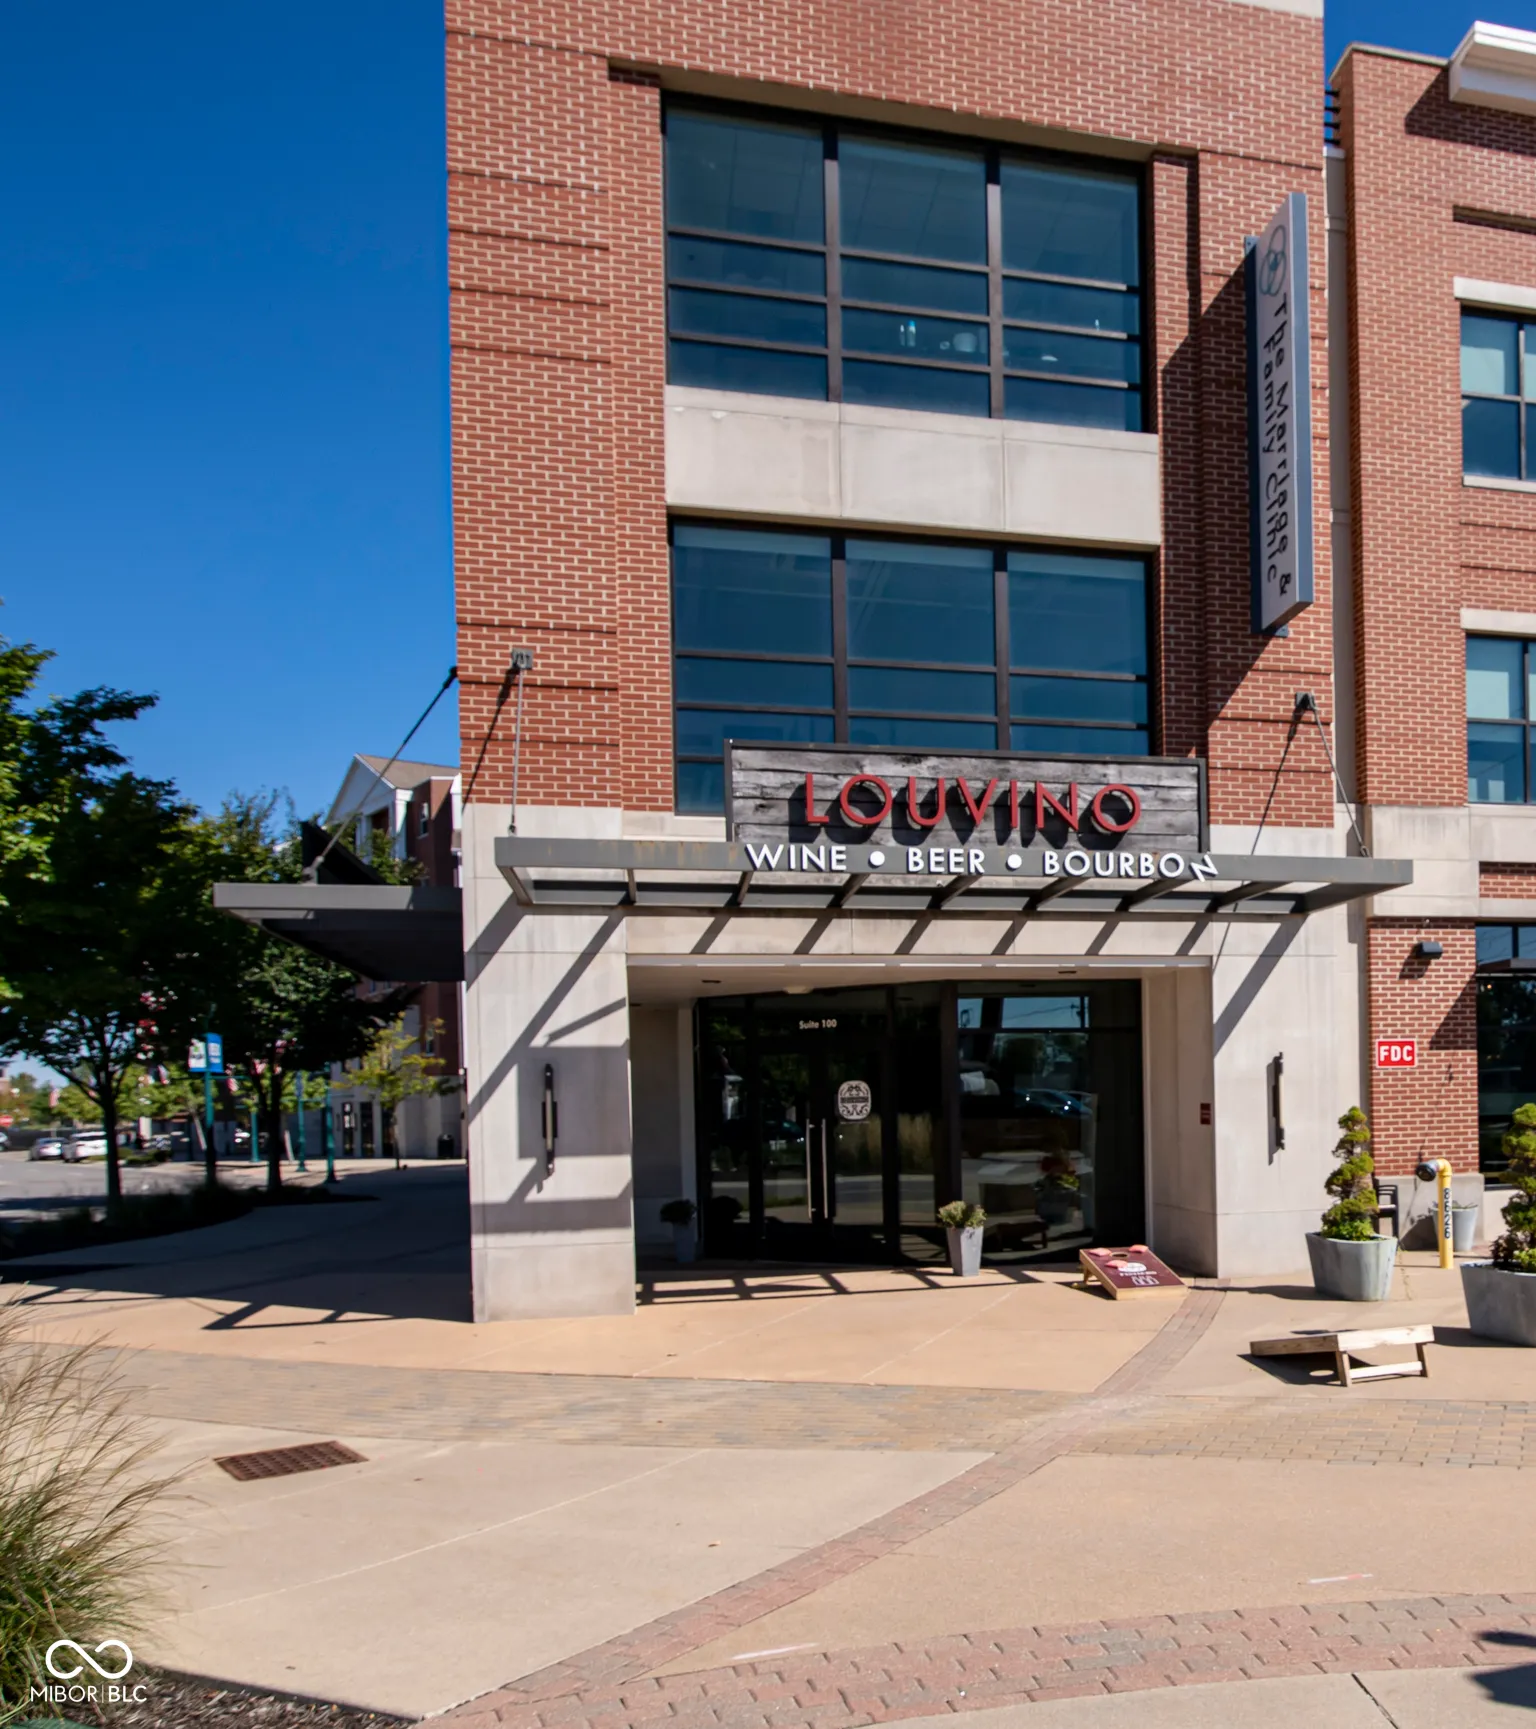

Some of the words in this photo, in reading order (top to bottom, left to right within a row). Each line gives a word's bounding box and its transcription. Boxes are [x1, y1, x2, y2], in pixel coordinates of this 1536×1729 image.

[1272, 292, 1288, 368] The
[1263, 335, 1277, 453] Family
[1275, 381, 1290, 554] Marriage
[1266, 472, 1280, 583] Clinic
[1280, 572, 1291, 597] &
[805, 773, 1142, 833] LOUVINO
[746, 843, 847, 872] WINE
[907, 847, 986, 874] BEER
[1043, 850, 1219, 882] BOURBON
[799, 1020, 820, 1030] Suite
[821, 1019, 838, 1029] 100
[1380, 1045, 1413, 1062] FDC
